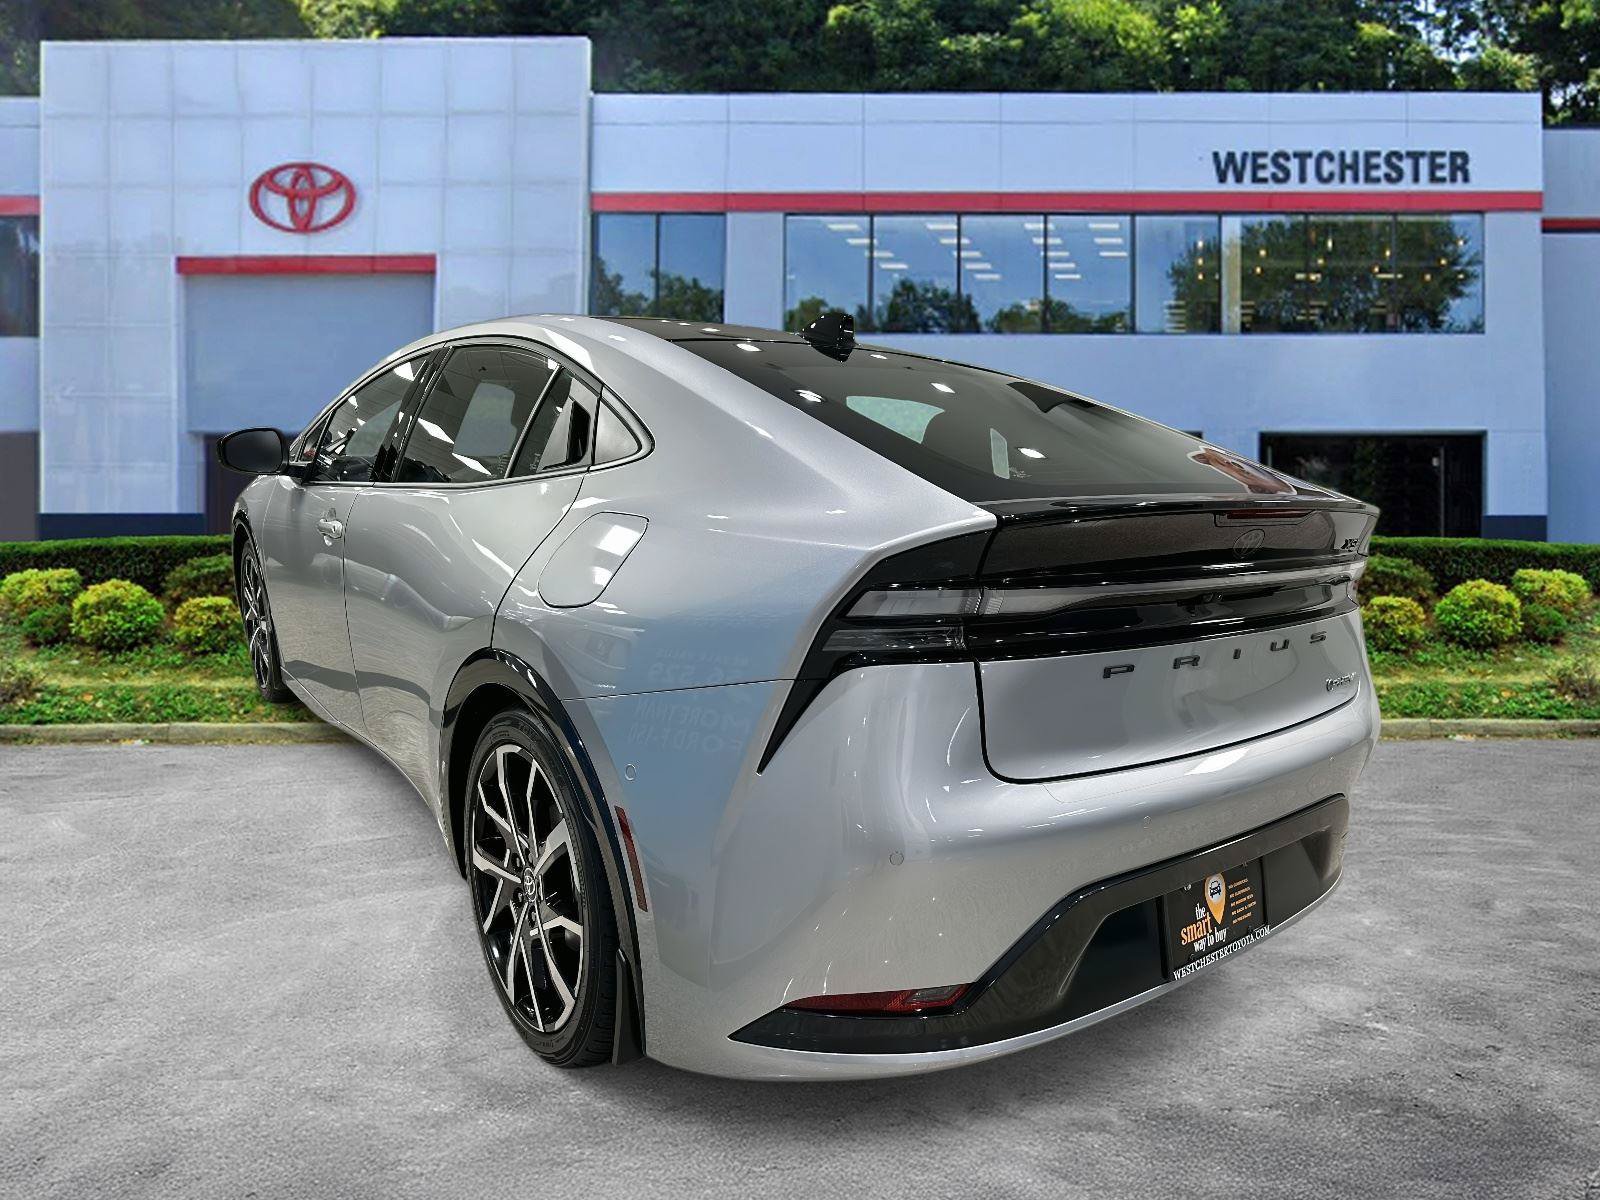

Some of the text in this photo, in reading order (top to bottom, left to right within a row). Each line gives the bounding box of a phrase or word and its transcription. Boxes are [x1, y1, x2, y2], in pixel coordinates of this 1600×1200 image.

[1212, 151, 1471, 184] WESTCHESTER
[1102, 631, 1328, 679] PRIUS
[1195, 903, 1206, 920] the
[1180, 912, 1212, 946] smart
[1193, 926, 1227, 953] way to buy
[1173, 924, 1271, 981] WESTCHESTERTOYOTA.COM
